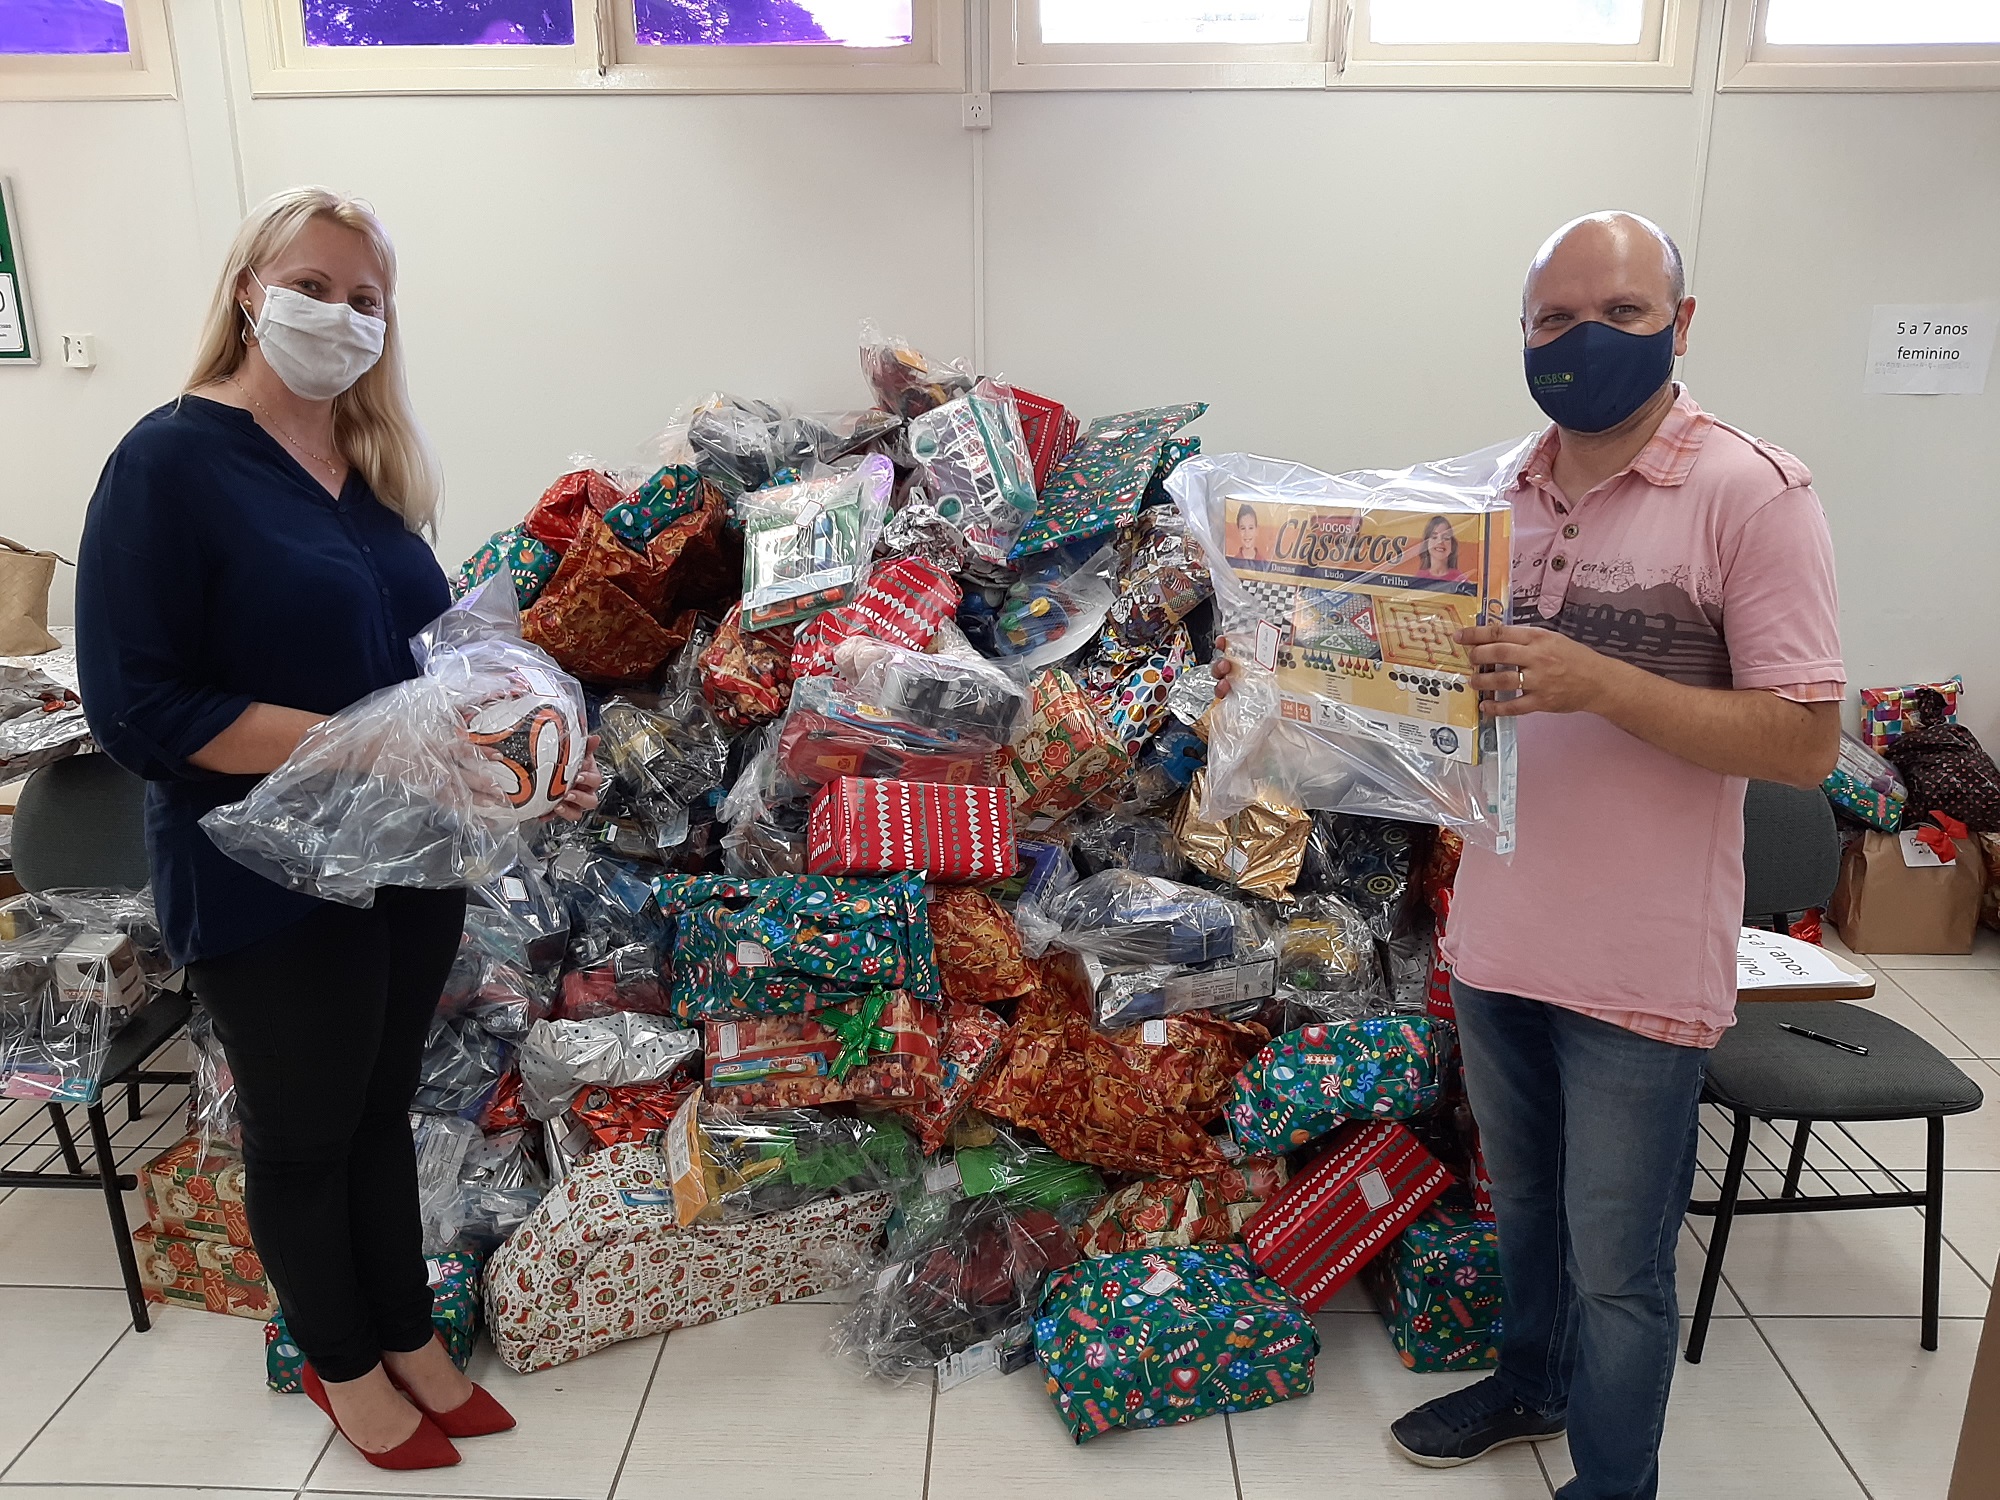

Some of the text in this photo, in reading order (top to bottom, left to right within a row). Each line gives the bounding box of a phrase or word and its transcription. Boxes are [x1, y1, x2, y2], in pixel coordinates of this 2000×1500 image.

[1896, 321, 1969, 335] 5 a 7 anos
[1897, 345, 1960, 360] feminino
[1320, 521, 1351, 534] JOGOS
[1274, 518, 1408, 567] Clássicos
[1271, 563, 1409, 587] Damas Ludo Trilha
[1769, 951, 1810, 976] anos
